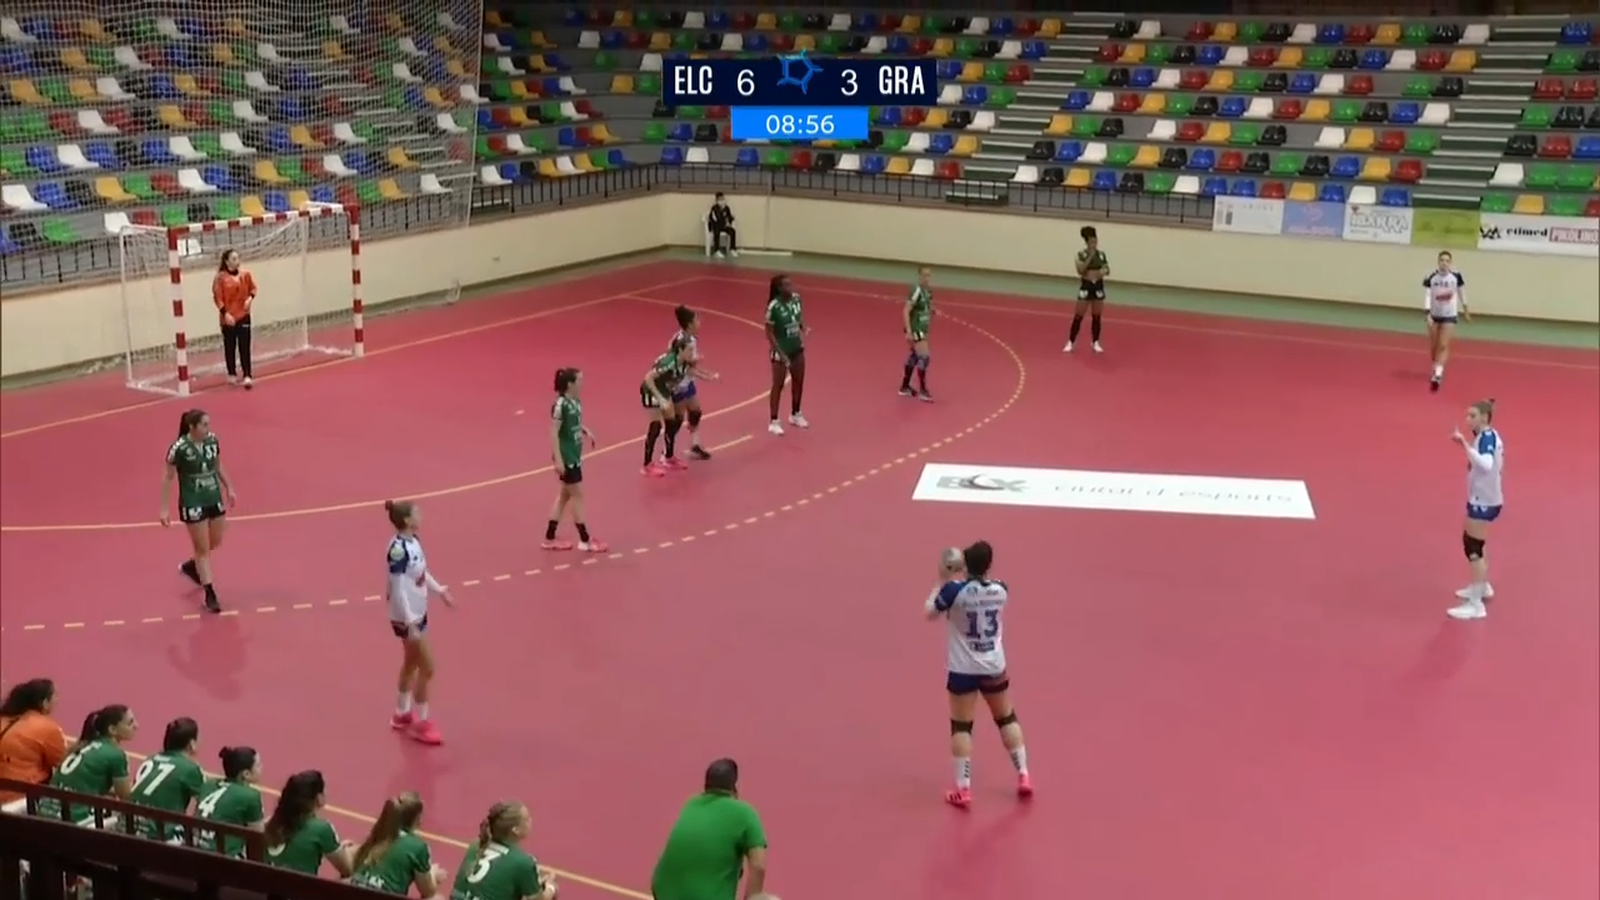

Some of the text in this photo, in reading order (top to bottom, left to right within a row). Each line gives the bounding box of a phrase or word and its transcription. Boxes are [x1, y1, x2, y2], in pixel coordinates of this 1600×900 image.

[966, 609, 999, 639] 13
[130, 759, 177, 796] 97
[198, 785, 229, 818] 4
